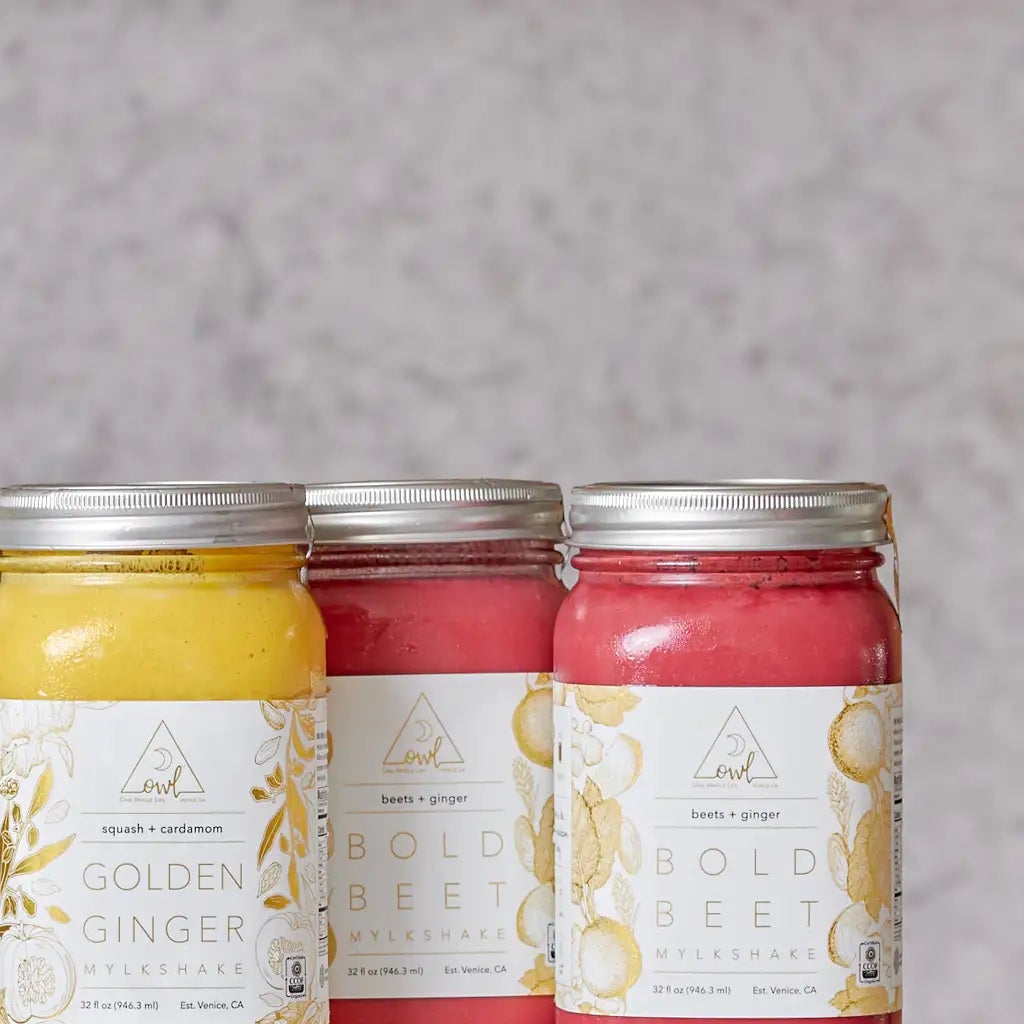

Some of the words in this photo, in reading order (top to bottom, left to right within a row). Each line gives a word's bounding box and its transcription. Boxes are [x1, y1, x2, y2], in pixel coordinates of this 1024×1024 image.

[403, 736, 442, 768] owl
[716, 751, 755, 783] owl
[143, 765, 182, 798] owl
[382, 794, 414, 804] beets
[430, 794, 467, 805] ginger
[692, 809, 724, 819] beets
[741, 810, 780, 821] ginger
[102, 823, 143, 836] squash
[161, 823, 223, 834] cardamom
[349, 831, 503, 859] BOLD
[657, 848, 816, 876] BOLD
[83, 863, 243, 890] GOLDEN
[349, 882, 506, 910] BEET
[657, 901, 818, 928] BEET
[83, 915, 244, 943] GINGER
[351, 928, 505, 942] MYLKSHAKE
[656, 948, 816, 961] MYLKSHAKE
[84, 963, 243, 975] MYLKSHAKE
[666, 985, 671, 993] fl
[686, 986, 714, 994] (946.3
[717, 986, 731, 994] ml)
[770, 987, 801, 995] Venice,
[804, 986, 816, 994] CA
[81, 1001, 91, 1009] 32
[94, 1001, 99, 1009] fl
[114, 1001, 141, 1011] (946.3
[144, 1001, 158, 1010] ml)
[181, 1002, 195, 1010] Est.
[198, 1002, 228, 1010] Venice,
[231, 1001, 244, 1009] CA
